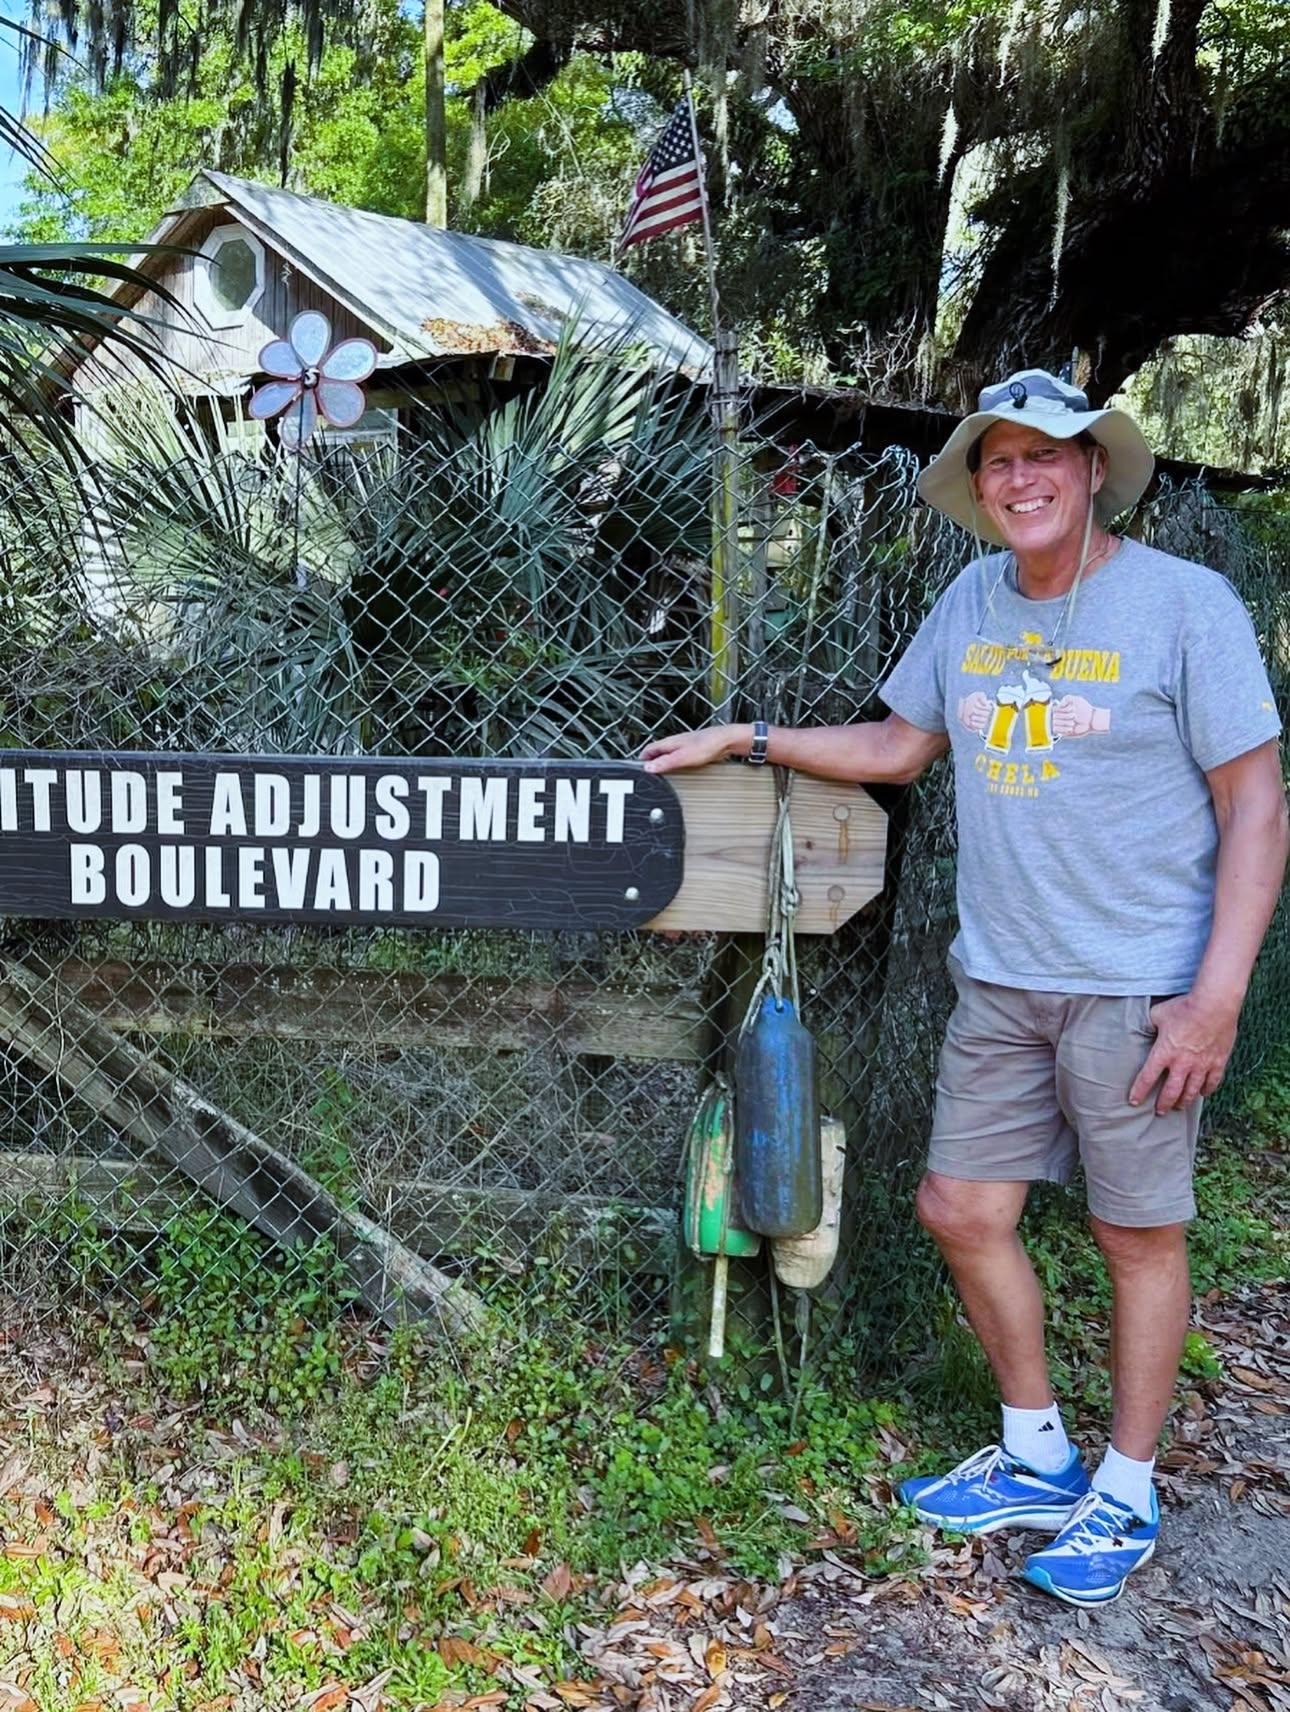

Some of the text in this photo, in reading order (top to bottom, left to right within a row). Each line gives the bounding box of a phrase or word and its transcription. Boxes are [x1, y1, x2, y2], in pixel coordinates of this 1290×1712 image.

[960, 643, 1006, 677] SALUD
[1049, 649, 1121, 684] BUENA
[975, 752, 1061, 785] CHELA
[0, 768, 635, 844] ITUDE ADJUSTMENT
[70, 843, 441, 913] BOULEVARD
